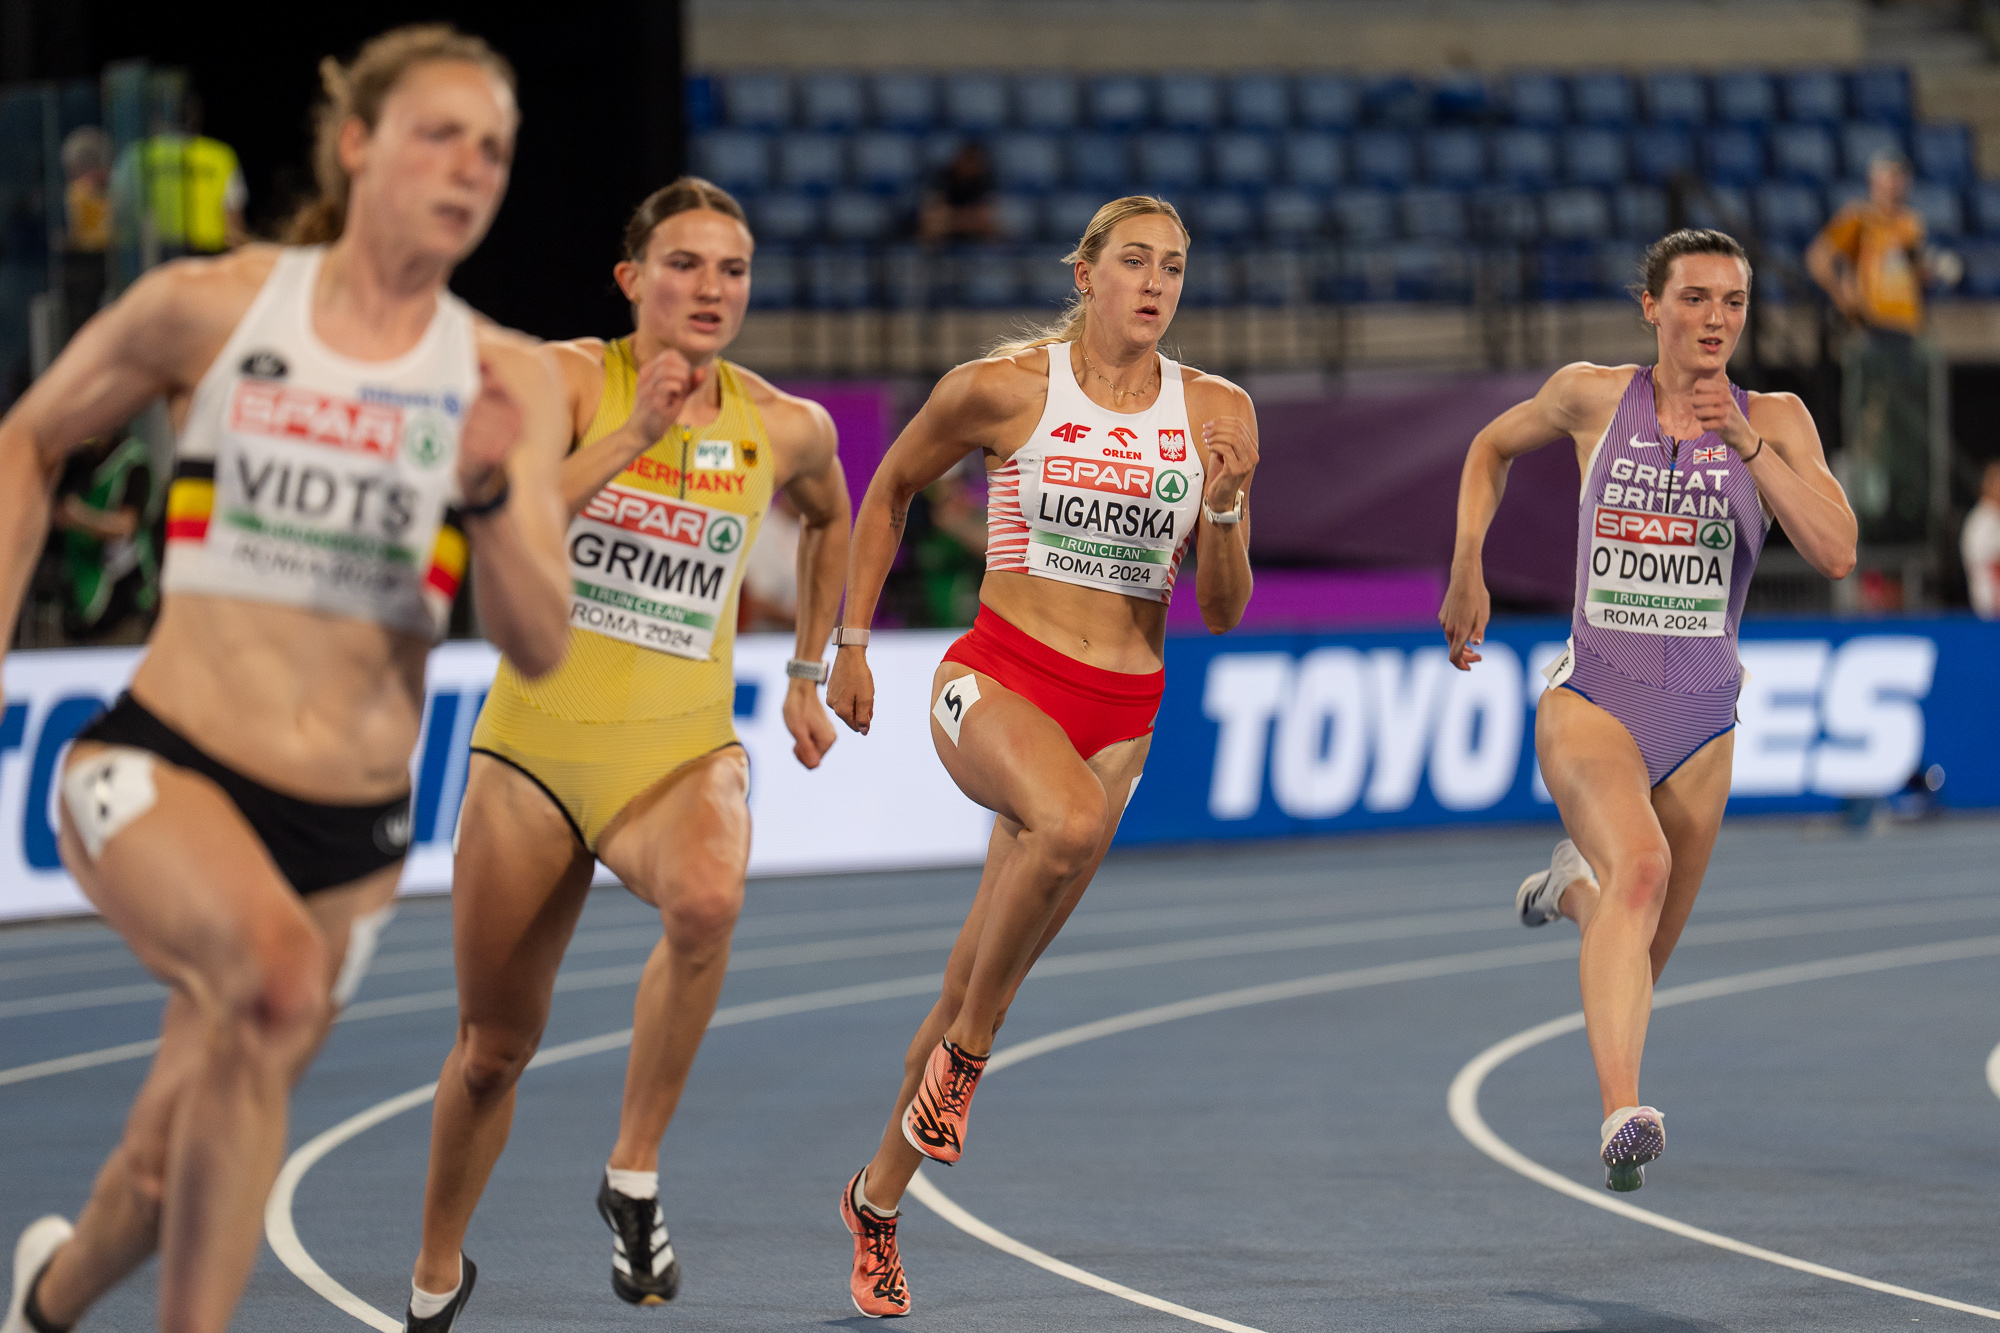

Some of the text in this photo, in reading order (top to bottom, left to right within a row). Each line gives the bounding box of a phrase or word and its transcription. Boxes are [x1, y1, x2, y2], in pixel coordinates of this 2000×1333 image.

[1050, 422, 1092, 443] 4F
[1102, 448, 1142, 461] ORLEN
[1046, 459, 1150, 494] SPAR
[1610, 457, 1730, 491] GREAT
[237, 454, 418, 536] VIDTS
[1603, 483, 1729, 518] BRITAIN
[585, 491, 704, 543] SPAR
[1039, 492, 1175, 540] LIGARSKA
[1598, 512, 1695, 543] SPAR
[1060, 537, 1066, 548] I
[1067, 538, 1097, 555] RUN
[571, 532, 726, 600] GRIMM
[1046, 552, 1151, 583] ROMA 2024
[598, 587, 633, 611] RUN
[1614, 592, 1618, 603] I
[1620, 593, 1649, 607] RUN
[570, 602, 693, 647] ROMA 2024
[1603, 609, 1708, 630] ROMA 2024
[1201, 641, 1527, 821] TOYO
